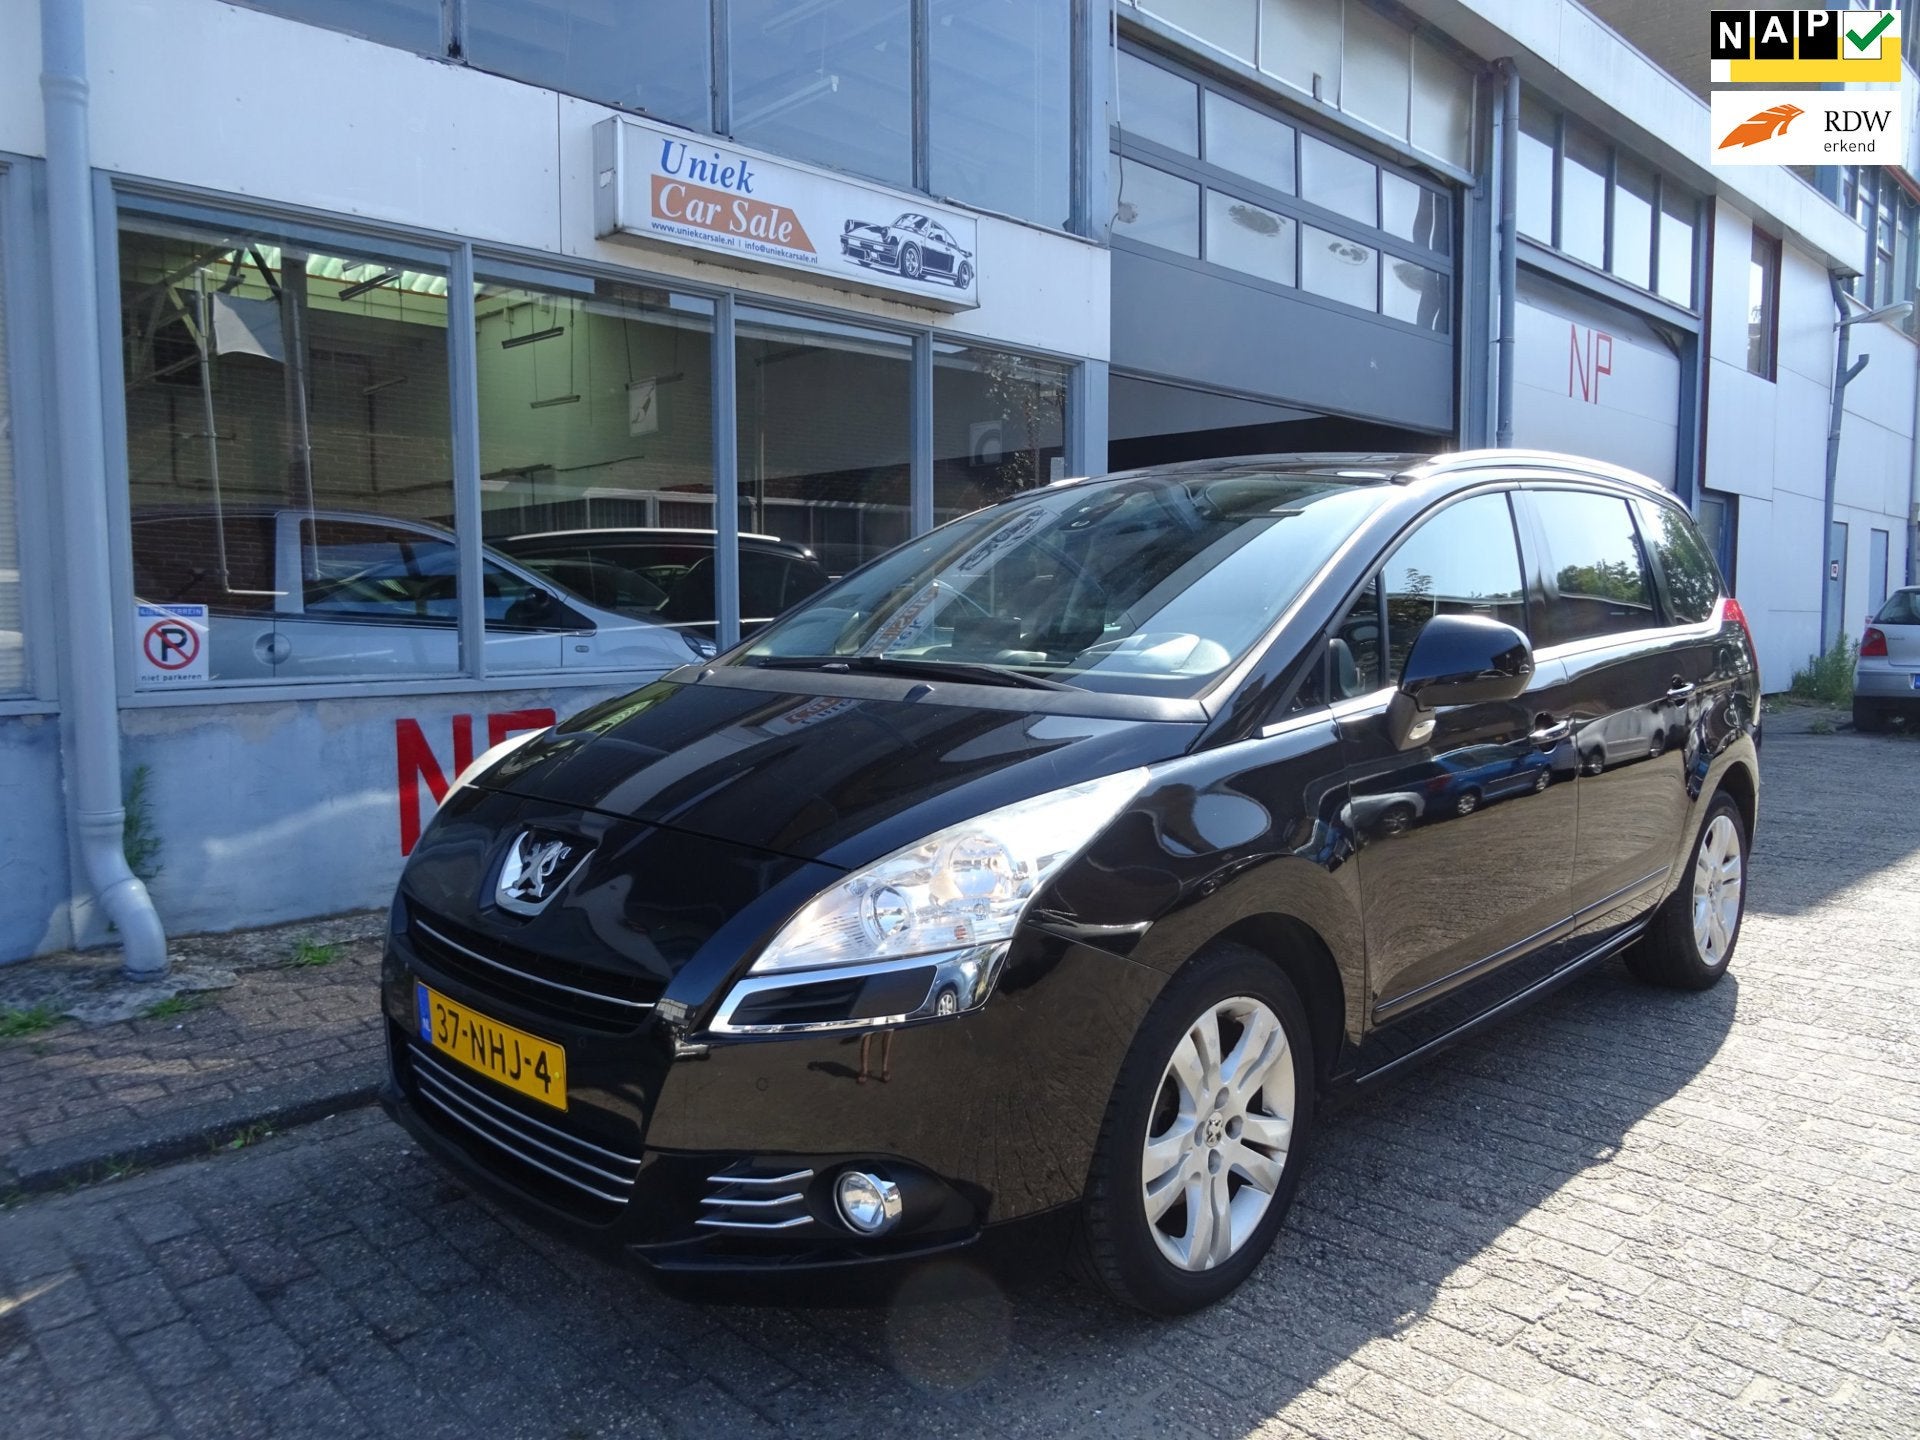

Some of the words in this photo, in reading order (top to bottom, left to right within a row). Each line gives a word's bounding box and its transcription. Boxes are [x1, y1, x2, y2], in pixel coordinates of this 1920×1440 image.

[660, 138, 755, 194] Uniek
[651, 221, 735, 246] www.uniekcarsale.nl
[744, 242, 818, 264] info@uniekcarsale.nl
[658, 183, 722, 225] Car
[729, 200, 794, 244] Sale
[1569, 323, 1612, 405] NP
[141, 674, 160, 682] niet
[163, 673, 202, 682] parkeren
[396, 708, 556, 857] N
[437, 1003, 552, 1094] 37-NHJ-4
